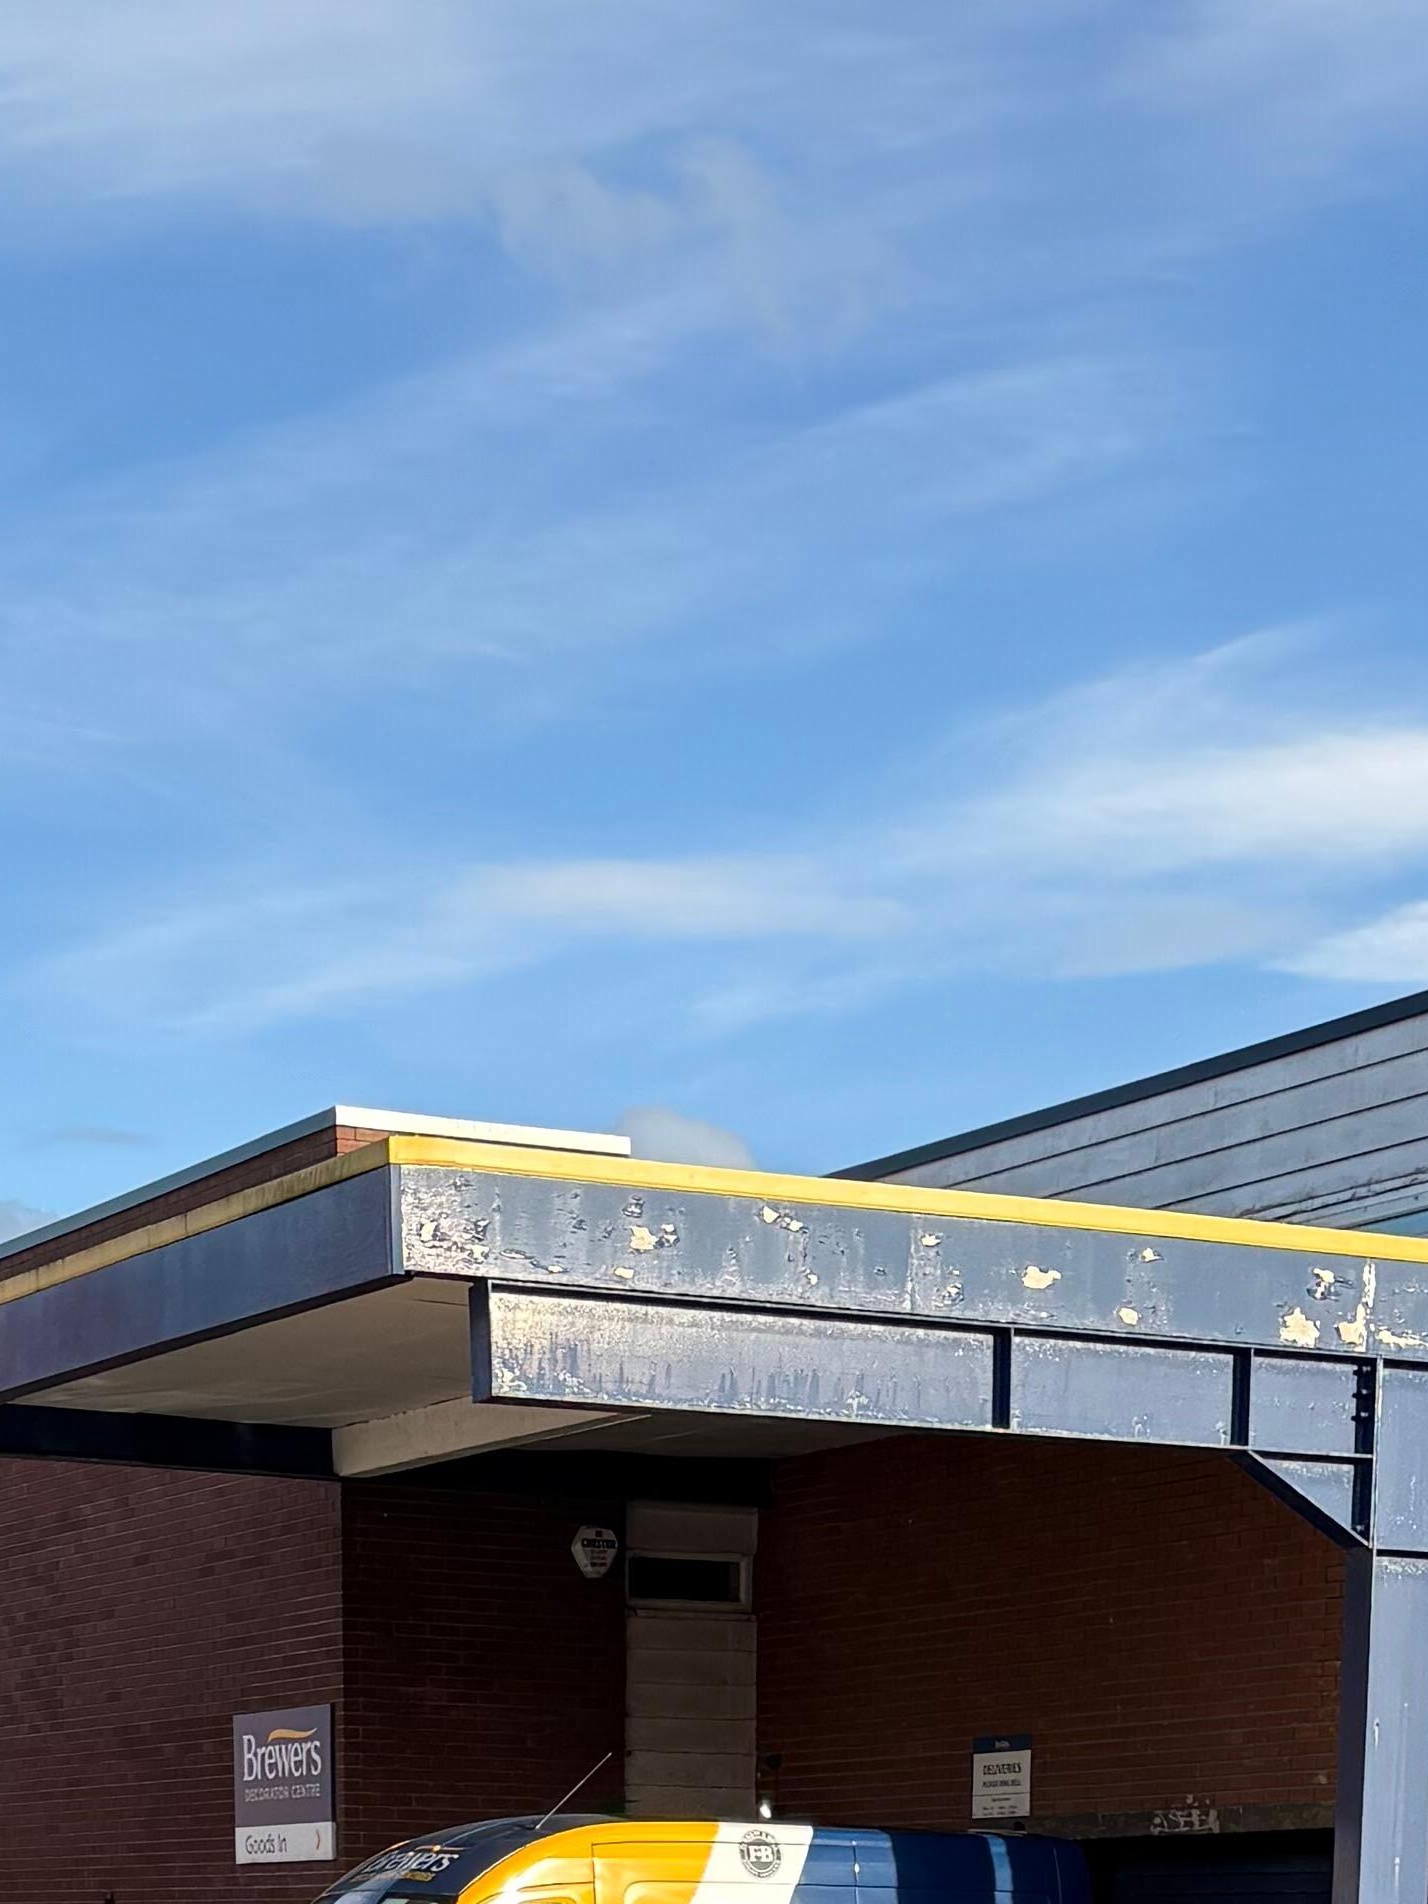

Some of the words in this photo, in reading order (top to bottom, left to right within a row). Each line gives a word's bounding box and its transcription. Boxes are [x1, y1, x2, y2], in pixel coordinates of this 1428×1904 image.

[242, 1735, 322, 1782] Brewers
[244, 1786, 290, 1802] DECORATOR
[245, 1834, 276, 1855] Goods
[277, 1833, 288, 1853] In
